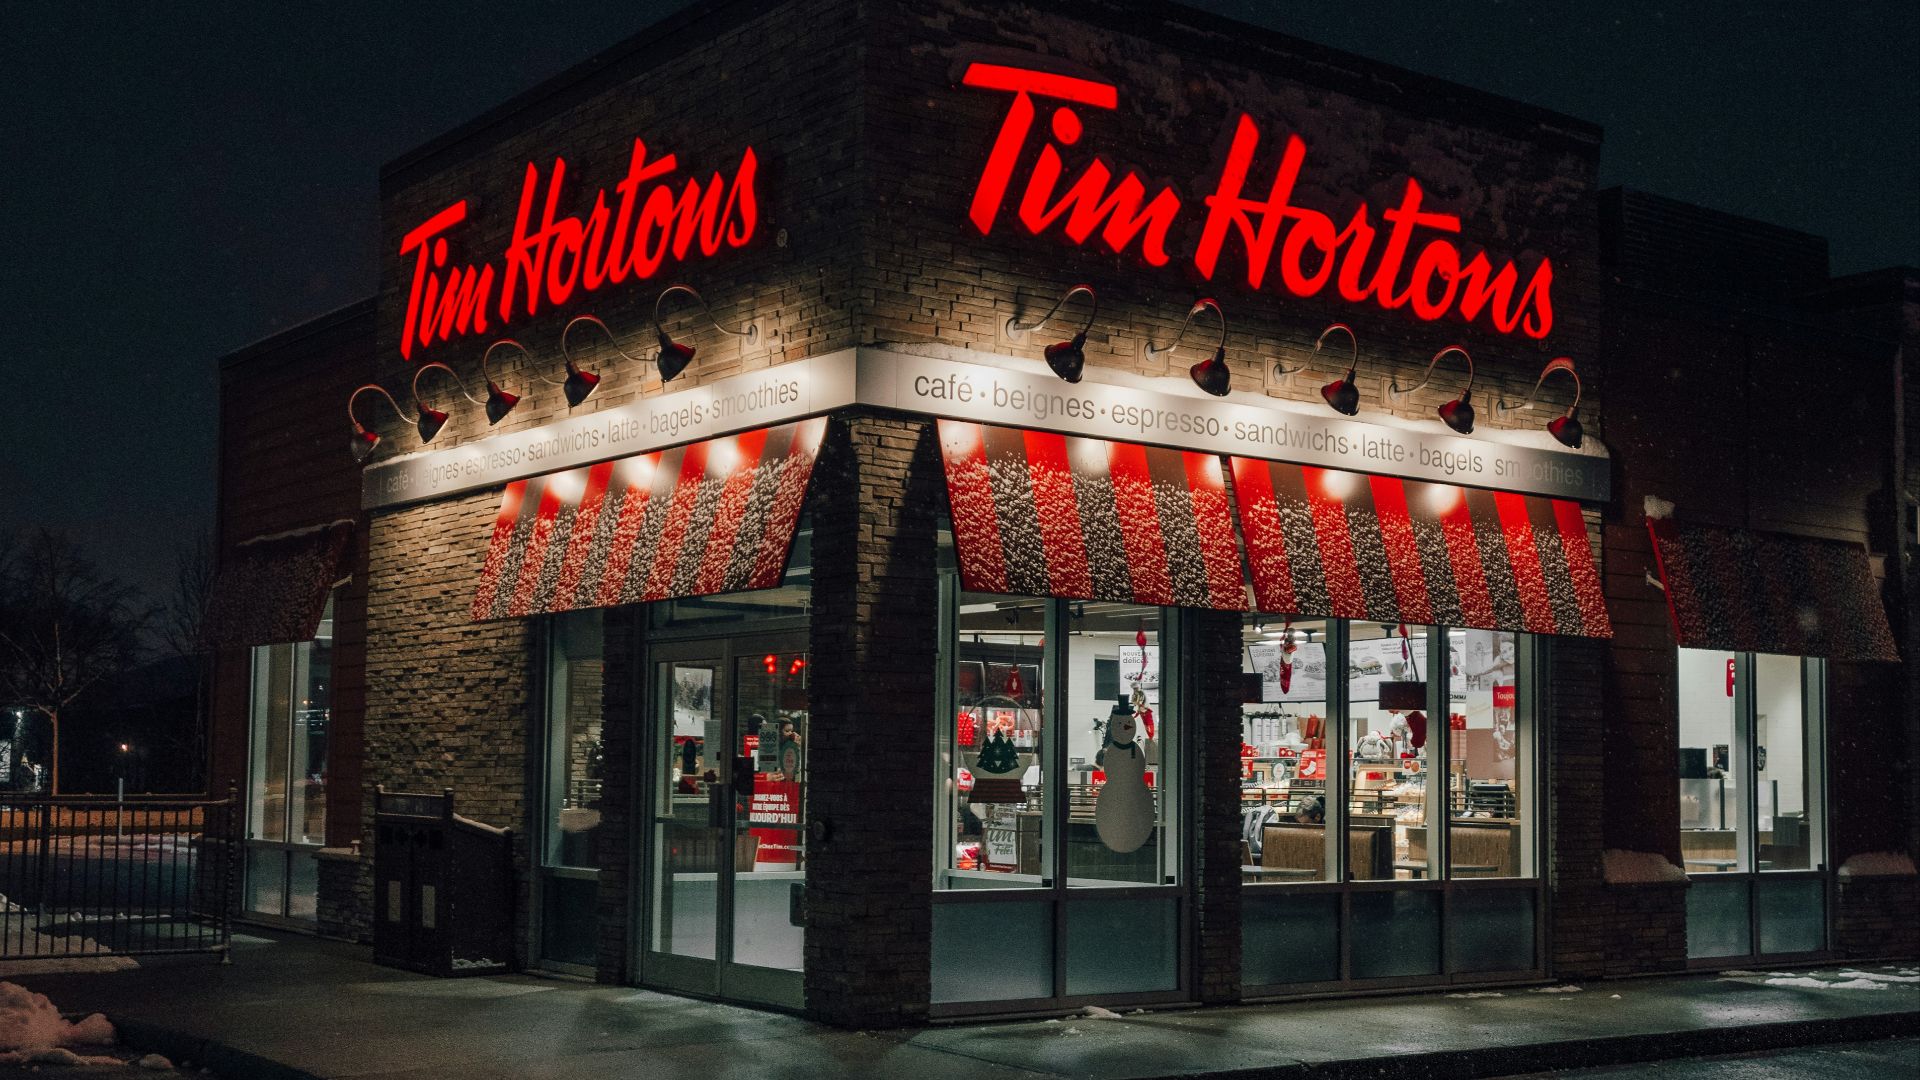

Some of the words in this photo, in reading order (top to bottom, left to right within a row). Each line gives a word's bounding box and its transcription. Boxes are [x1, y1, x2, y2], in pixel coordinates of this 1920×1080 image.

[400, 199, 494, 361] Tim
[500, 136, 758, 324] Hortons
[962, 62, 1181, 267] Tim
[1195, 112, 1554, 340] Hortons
[386, 467, 409, 493] café
[420, 459, 459, 489] eignes
[465, 445, 521, 479] espresso
[527, 425, 600, 461] sandwichs
[607, 418, 639, 444] latte
[649, 400, 703, 437] bagels
[712, 379, 799, 420] smoothies
[914, 374, 973, 402] café
[993, 380, 1095, 420] beignes
[1112, 403, 1220, 437] espresso
[1234, 421, 1349, 455] sandwichs
[1362, 433, 1405, 463] latte
[1419, 442, 1483, 475] bagels
[1495, 456, 1584, 486] smothies
[1122, 656, 1149, 664] délic
